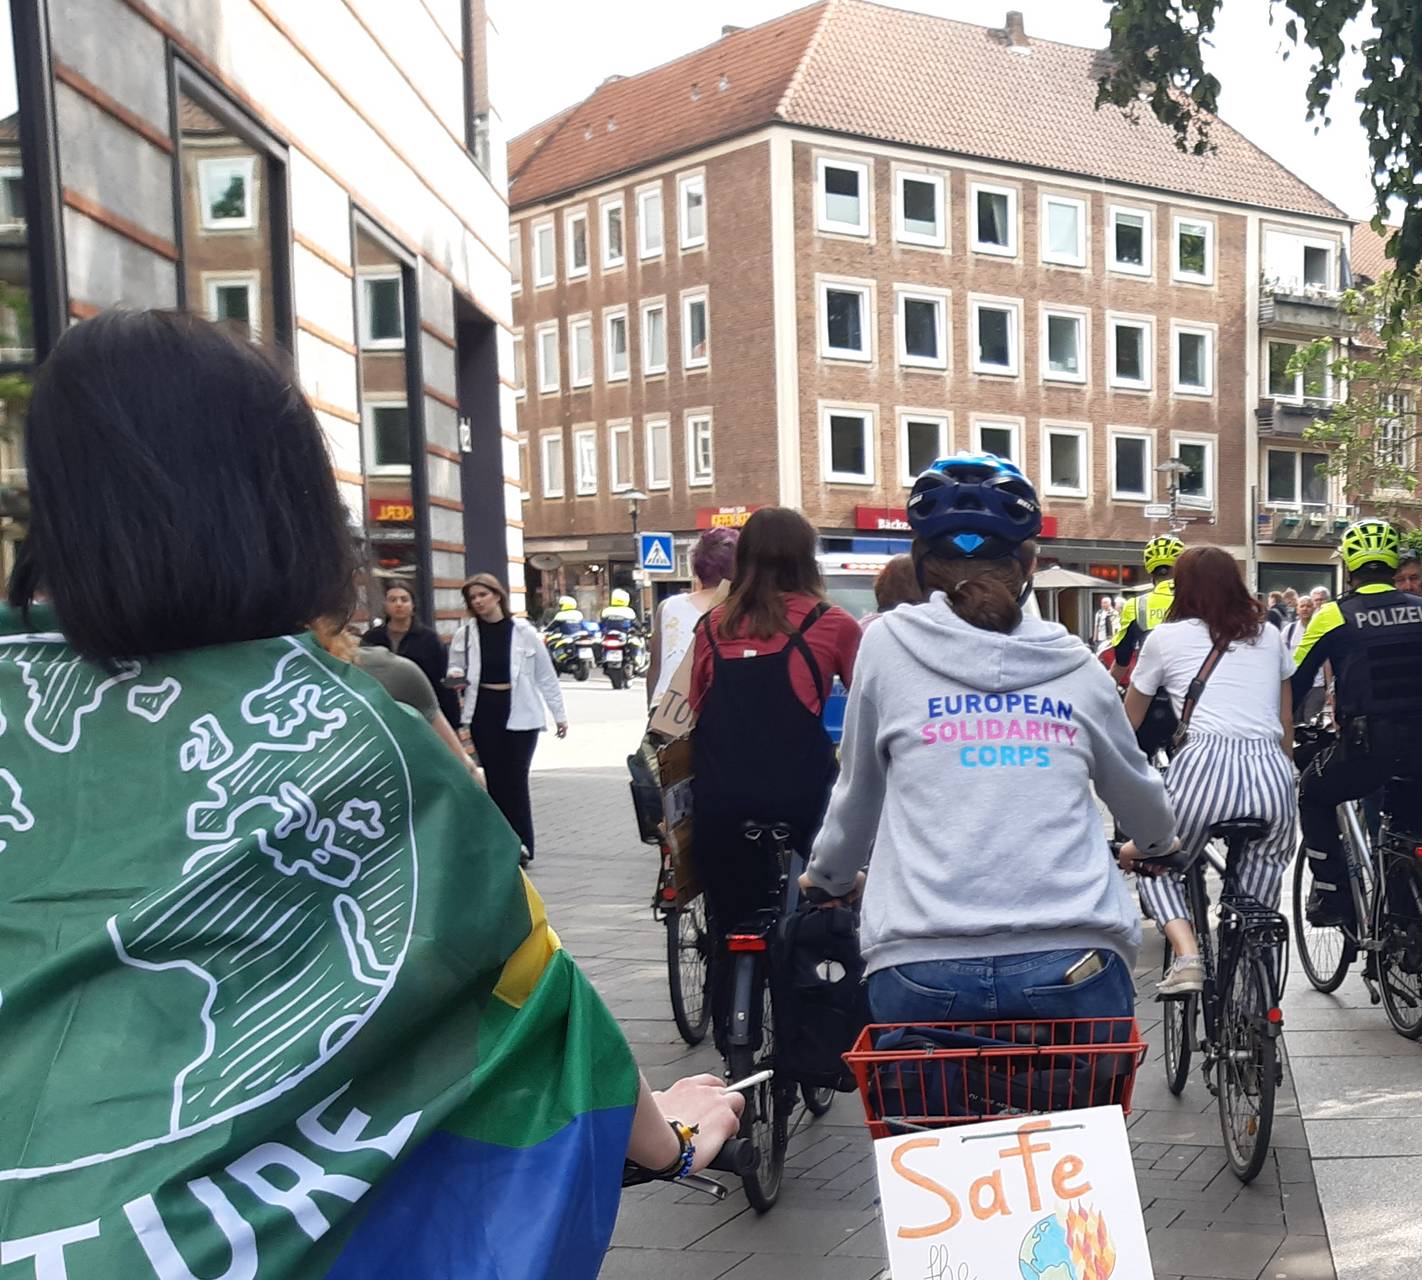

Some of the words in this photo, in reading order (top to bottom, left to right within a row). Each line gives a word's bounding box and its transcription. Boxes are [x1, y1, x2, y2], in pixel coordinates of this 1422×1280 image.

[1150, 608, 1167, 620] PO
[928, 694, 1073, 721] EUROPEAN
[922, 719, 1078, 746] SOLIDARITY
[960, 745, 1052, 768] CORPS
[891, 1120, 1093, 1239] Safe
